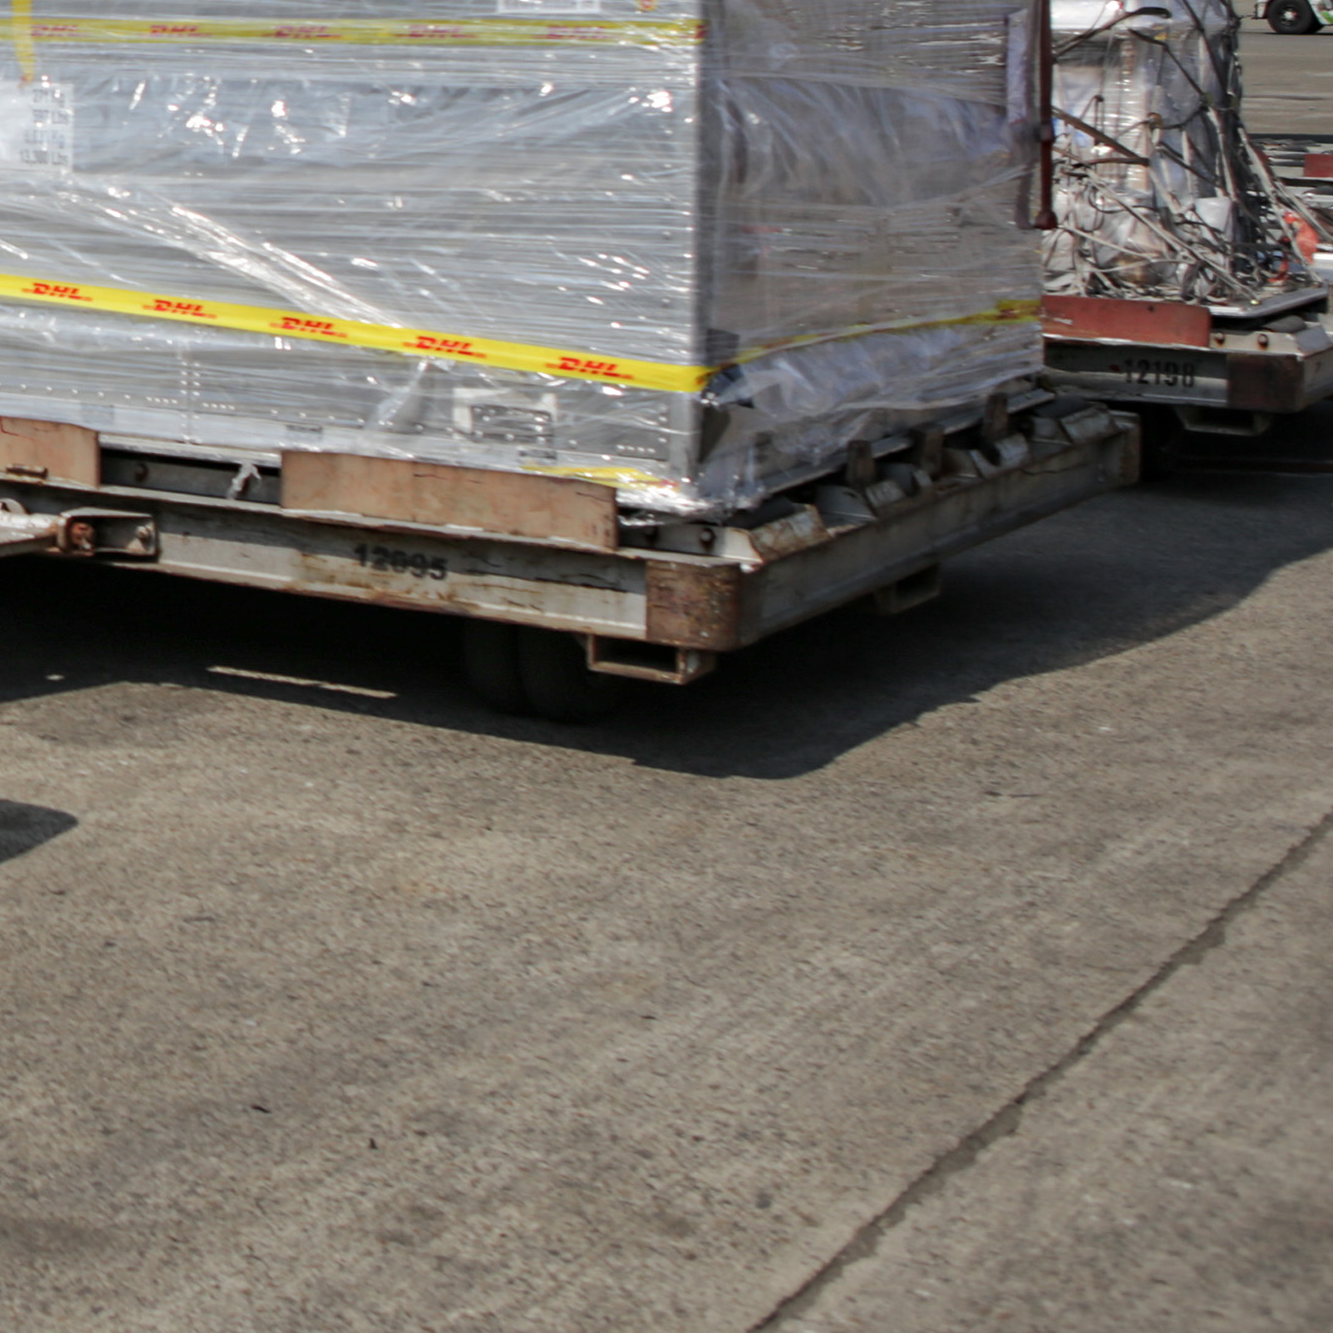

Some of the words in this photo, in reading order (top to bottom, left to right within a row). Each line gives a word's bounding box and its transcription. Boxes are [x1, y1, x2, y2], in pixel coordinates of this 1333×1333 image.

[33, 282, 82, 300] DHL
[154, 299, 205, 317] DHL
[282, 317, 334, 336] DHL
[416, 335, 474, 355] DHL
[559, 356, 621, 378] DHL
